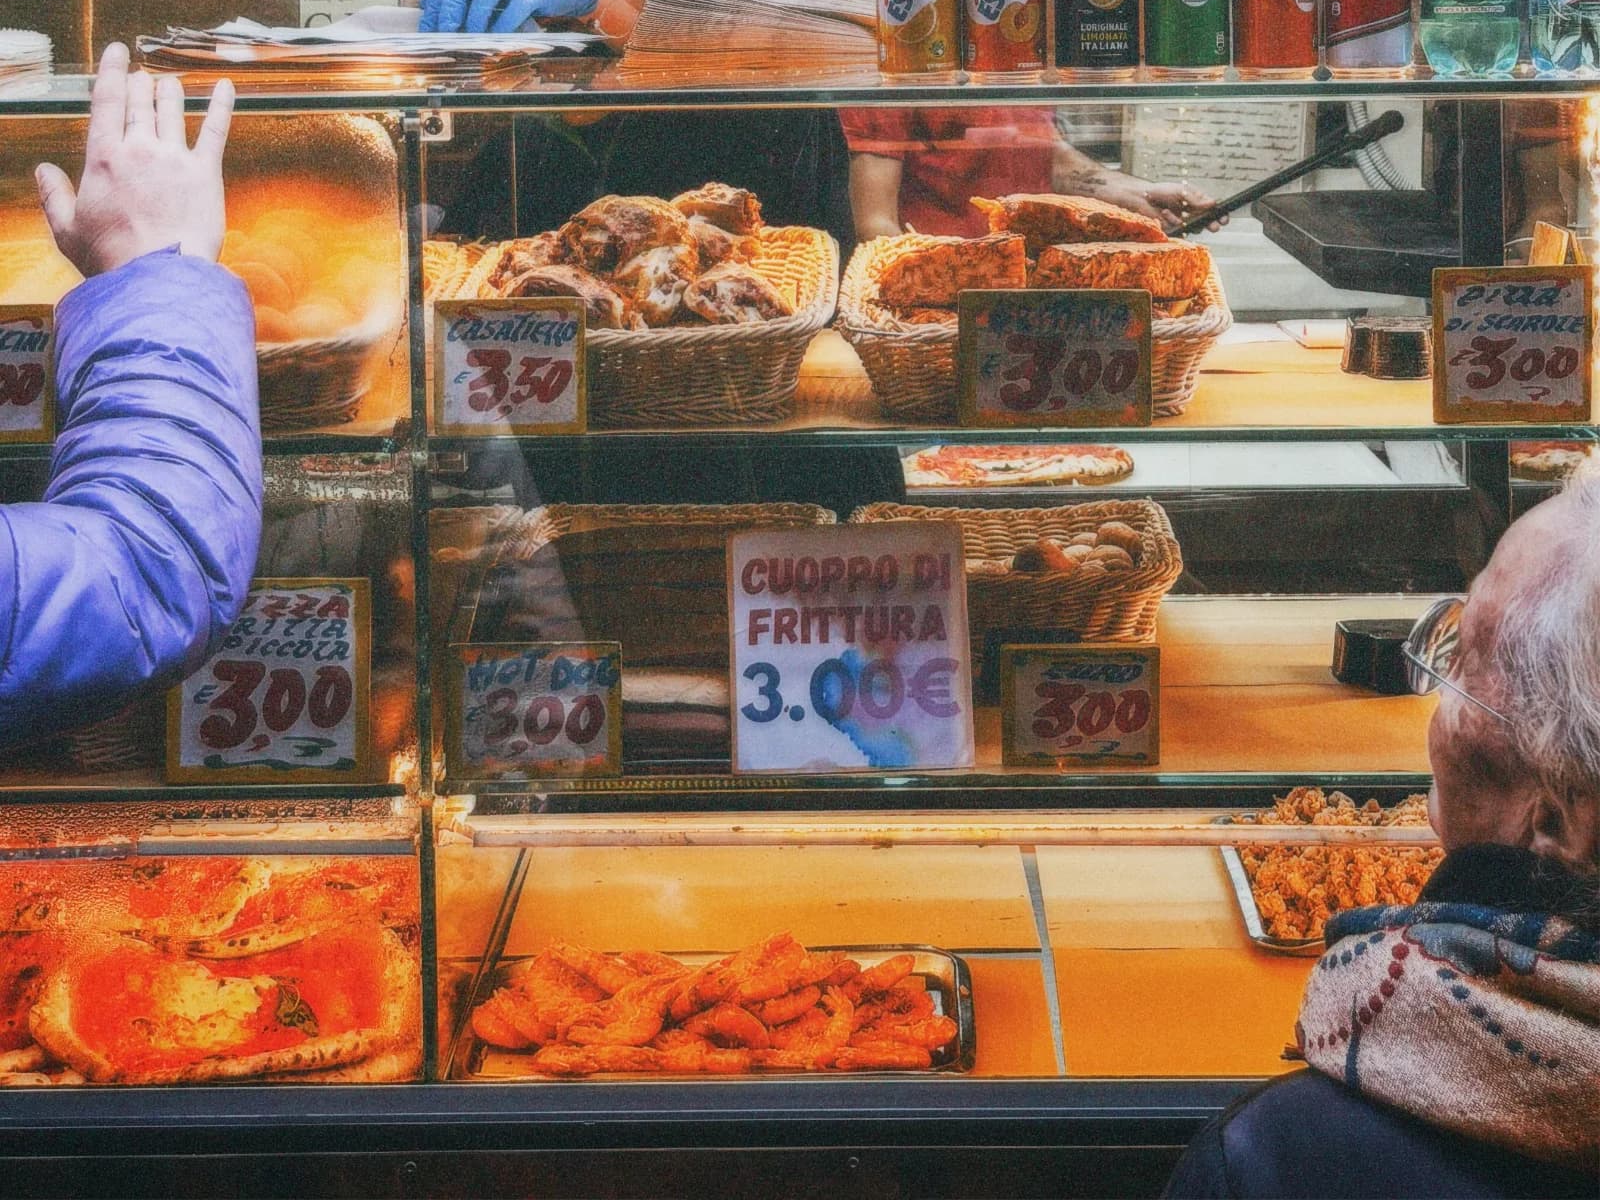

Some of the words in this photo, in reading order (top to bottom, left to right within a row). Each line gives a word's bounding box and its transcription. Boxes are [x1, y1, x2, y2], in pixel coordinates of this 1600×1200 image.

[1081, 42, 1129, 50] ITALIANA
[741, 555, 901, 595] CUOPPO
[912, 553, 952, 591] DI
[748, 604, 948, 645] FRITTURA
[741, 658, 961, 723] 3.00€
